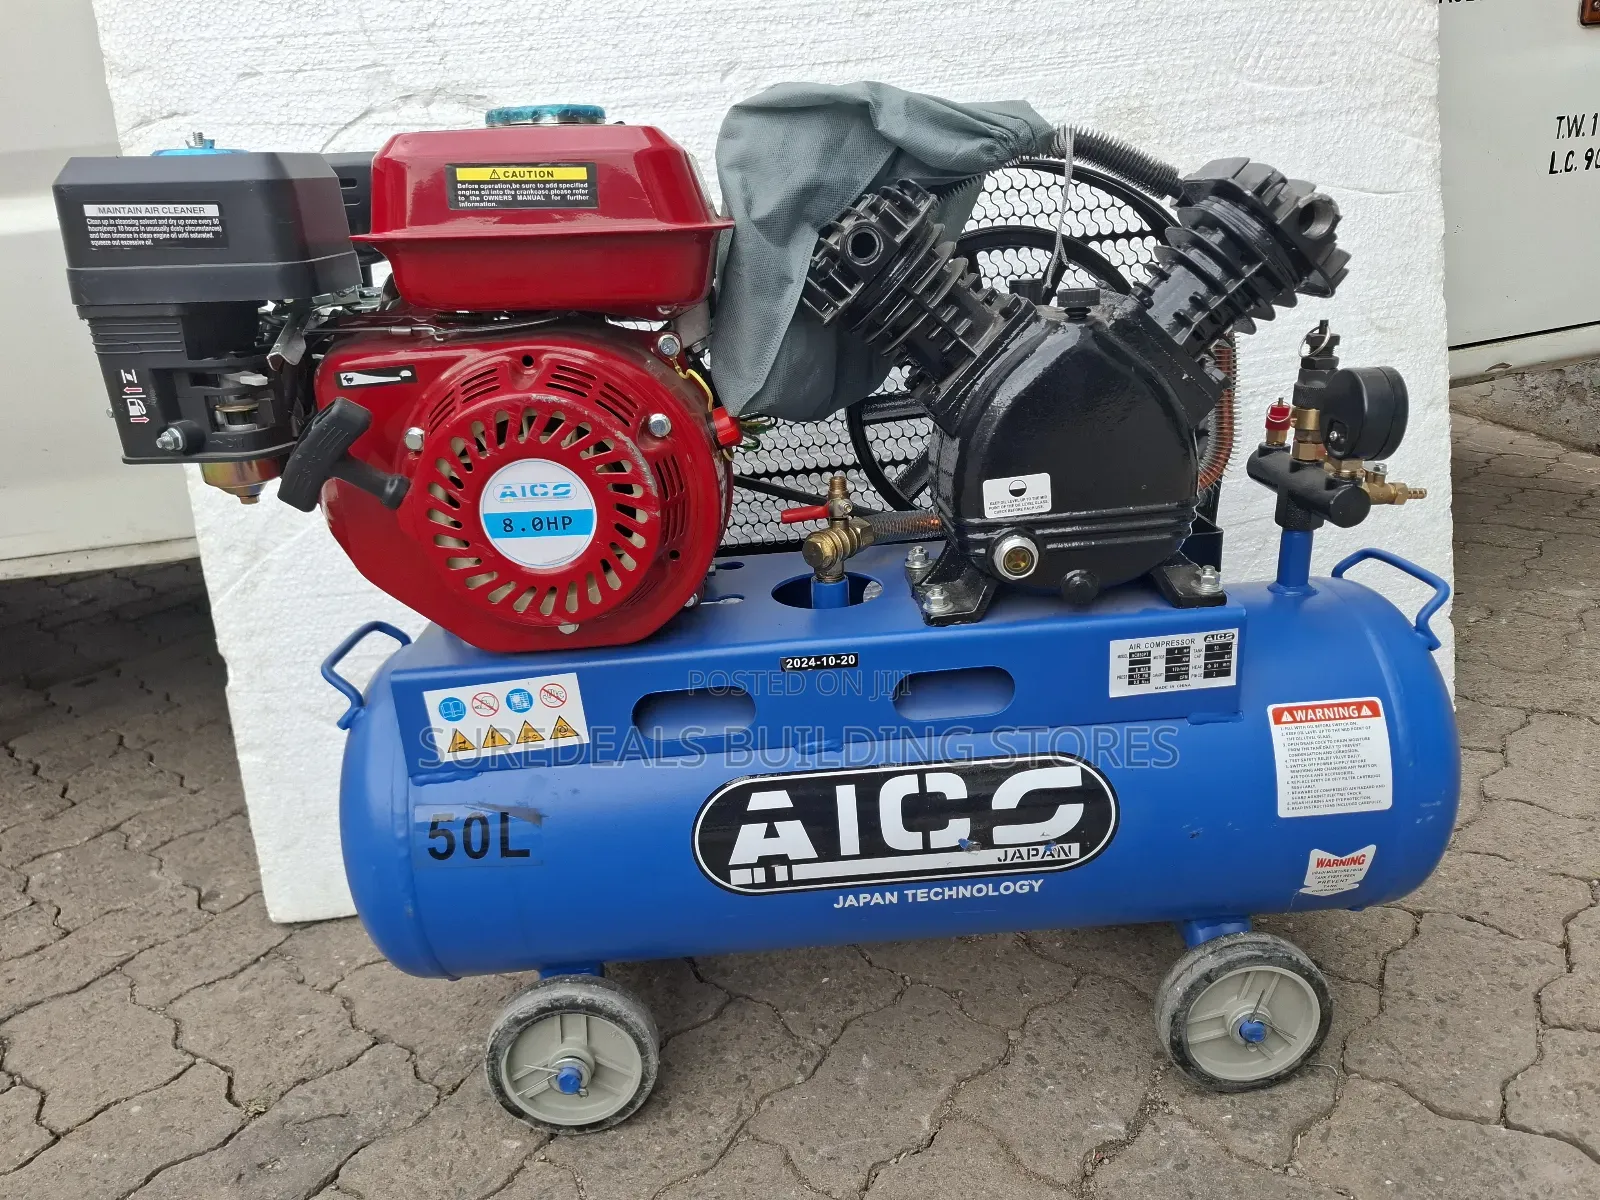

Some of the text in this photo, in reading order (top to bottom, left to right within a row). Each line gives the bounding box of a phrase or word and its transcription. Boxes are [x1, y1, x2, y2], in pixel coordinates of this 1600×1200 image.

[1556, 113, 1585, 139] T.W.
[1549, 150, 1577, 174] L.C.
[499, 483, 571, 498] AICS
[502, 515, 573, 532] 8.0HP
[1144, 638, 1196, 649] COMPRESSOR
[1206, 633, 1233, 642] AICS
[785, 655, 856, 668] 2024-10-20
[1293, 705, 1359, 721] WARNING
[728, 765, 1085, 866] AICS
[427, 811, 531, 861] 50L
[997, 844, 1072, 862] JAPAN
[1316, 854, 1367, 868] WARNING
[833, 879, 1044, 909] JAPAN TECHNOLOGY
